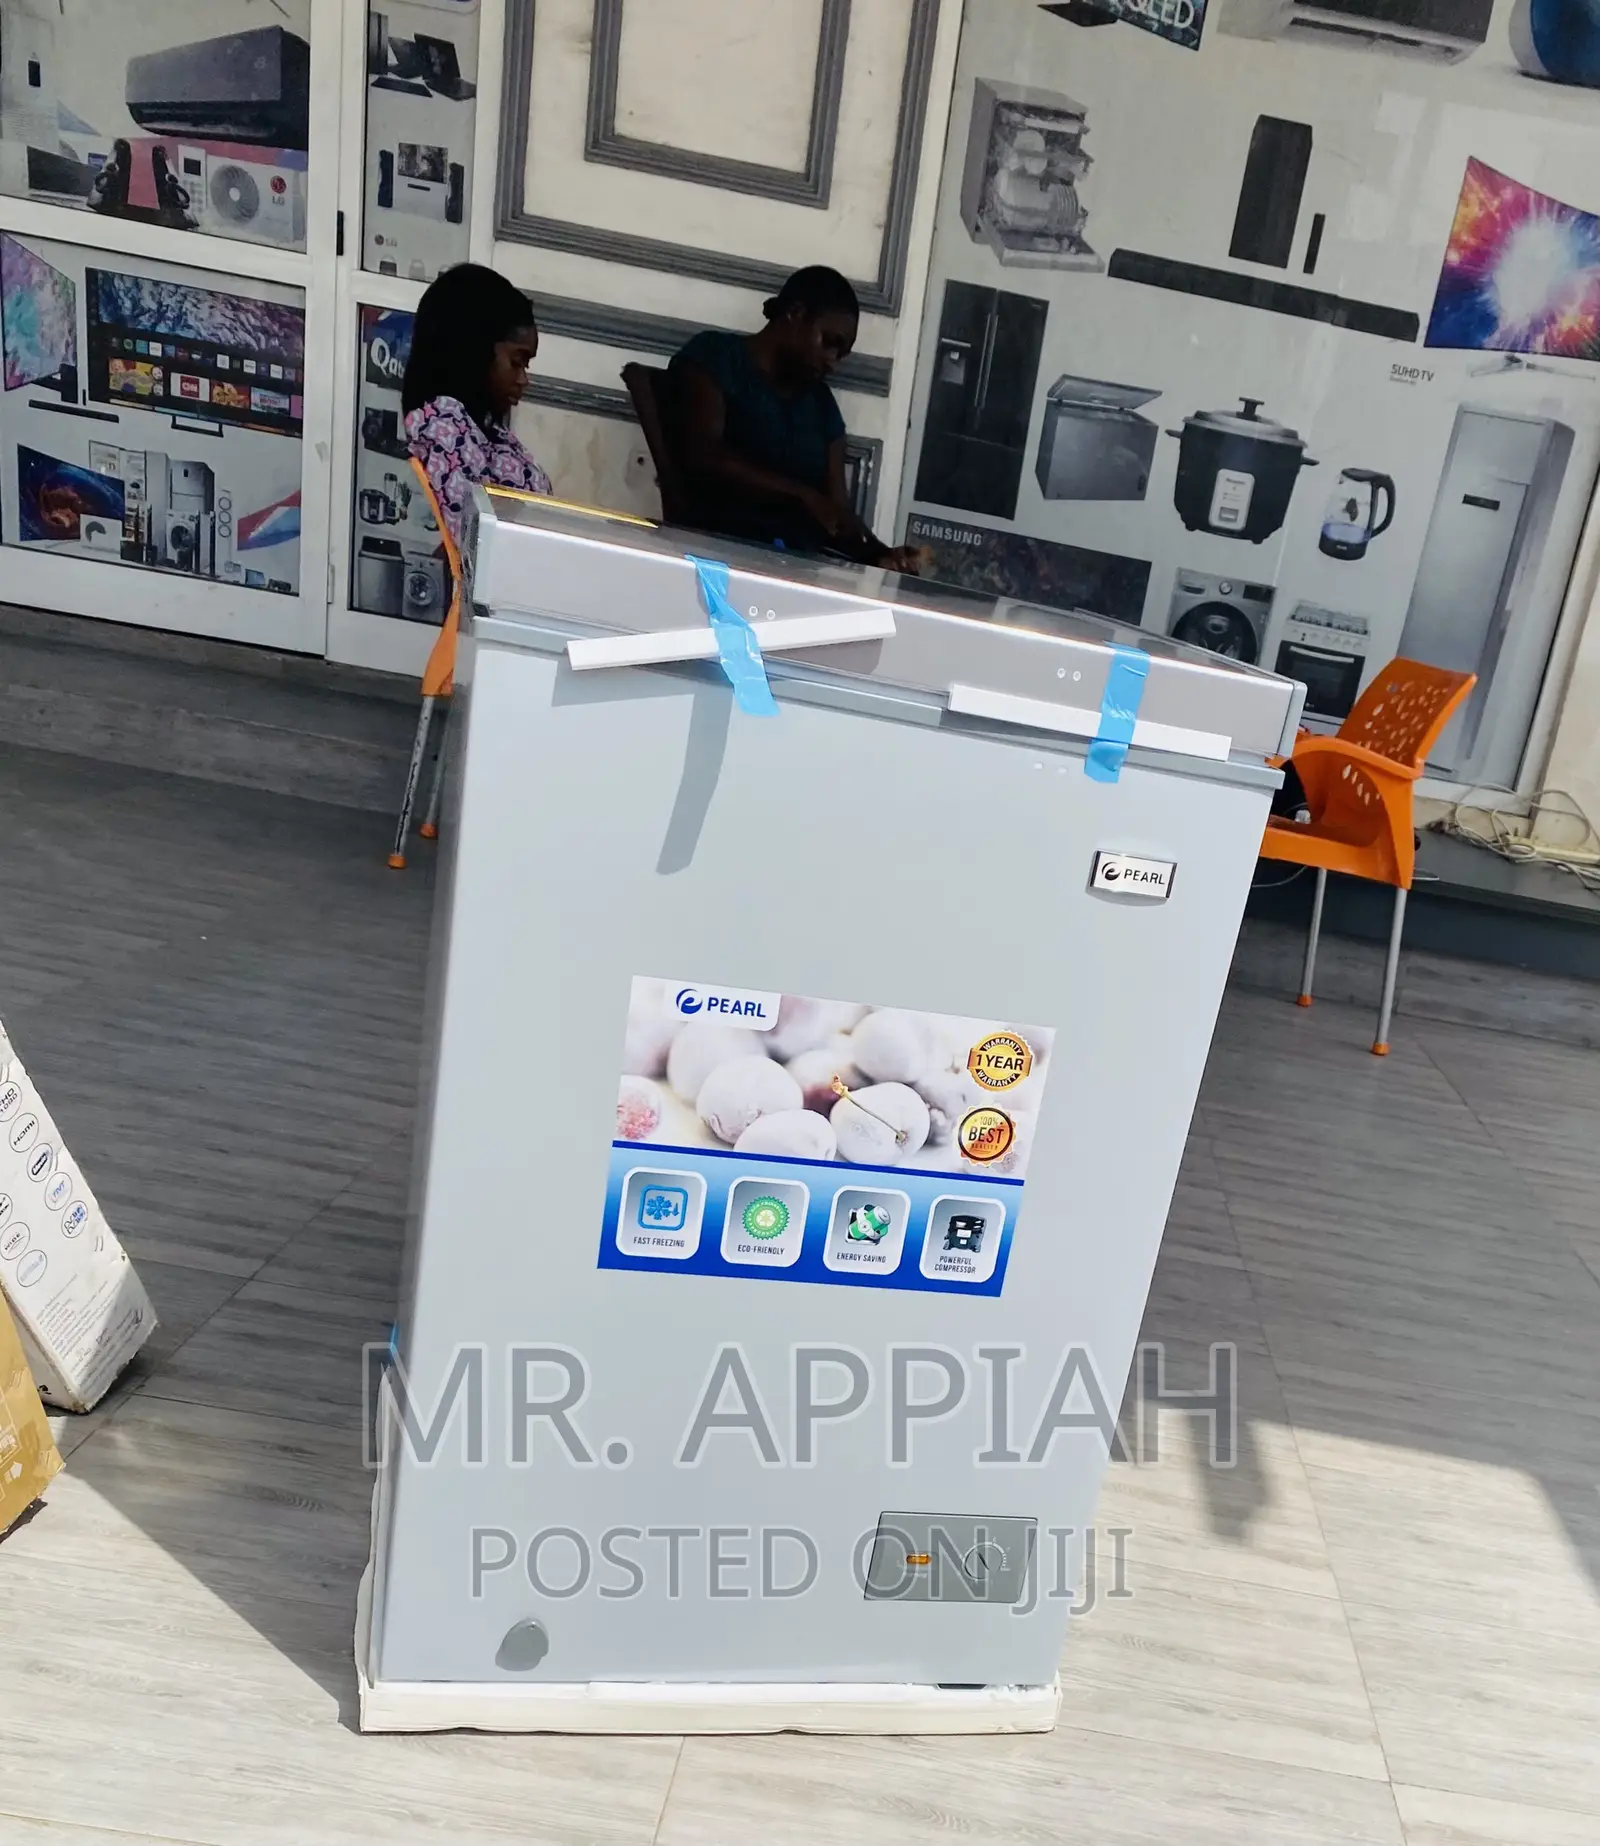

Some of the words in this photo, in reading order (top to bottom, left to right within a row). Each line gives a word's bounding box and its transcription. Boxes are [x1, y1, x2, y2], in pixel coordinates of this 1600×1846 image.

[1421, 370, 1435, 382] TV
[912, 520, 982, 546] SAMSUNG
[1123, 867, 1165, 885] PEARL
[707, 996, 766, 1018] PEARL
[983, 1037, 1022, 1056] WARRANTY
[976, 1054, 983, 1066] 1
[986, 1054, 1025, 1071] YEAR
[977, 1069, 1017, 1087] WARRANTY
[0, 1088, 15, 1106] HD
[980, 1116, 999, 1126] 100%
[968, 1126, 1005, 1144] BEST
[633, 1236, 651, 1245] FAST
[652, 1237, 685, 1247] FREEZING
[737, 1244, 785, 1255] ECO-FRIENDLY
[836, 1252, 861, 1261] ENERGY
[863, 1254, 887, 1263] SAVING
[940, 1255, 972, 1265] POWERFUL
[934, 1263, 976, 1274] COMPRESSOR
